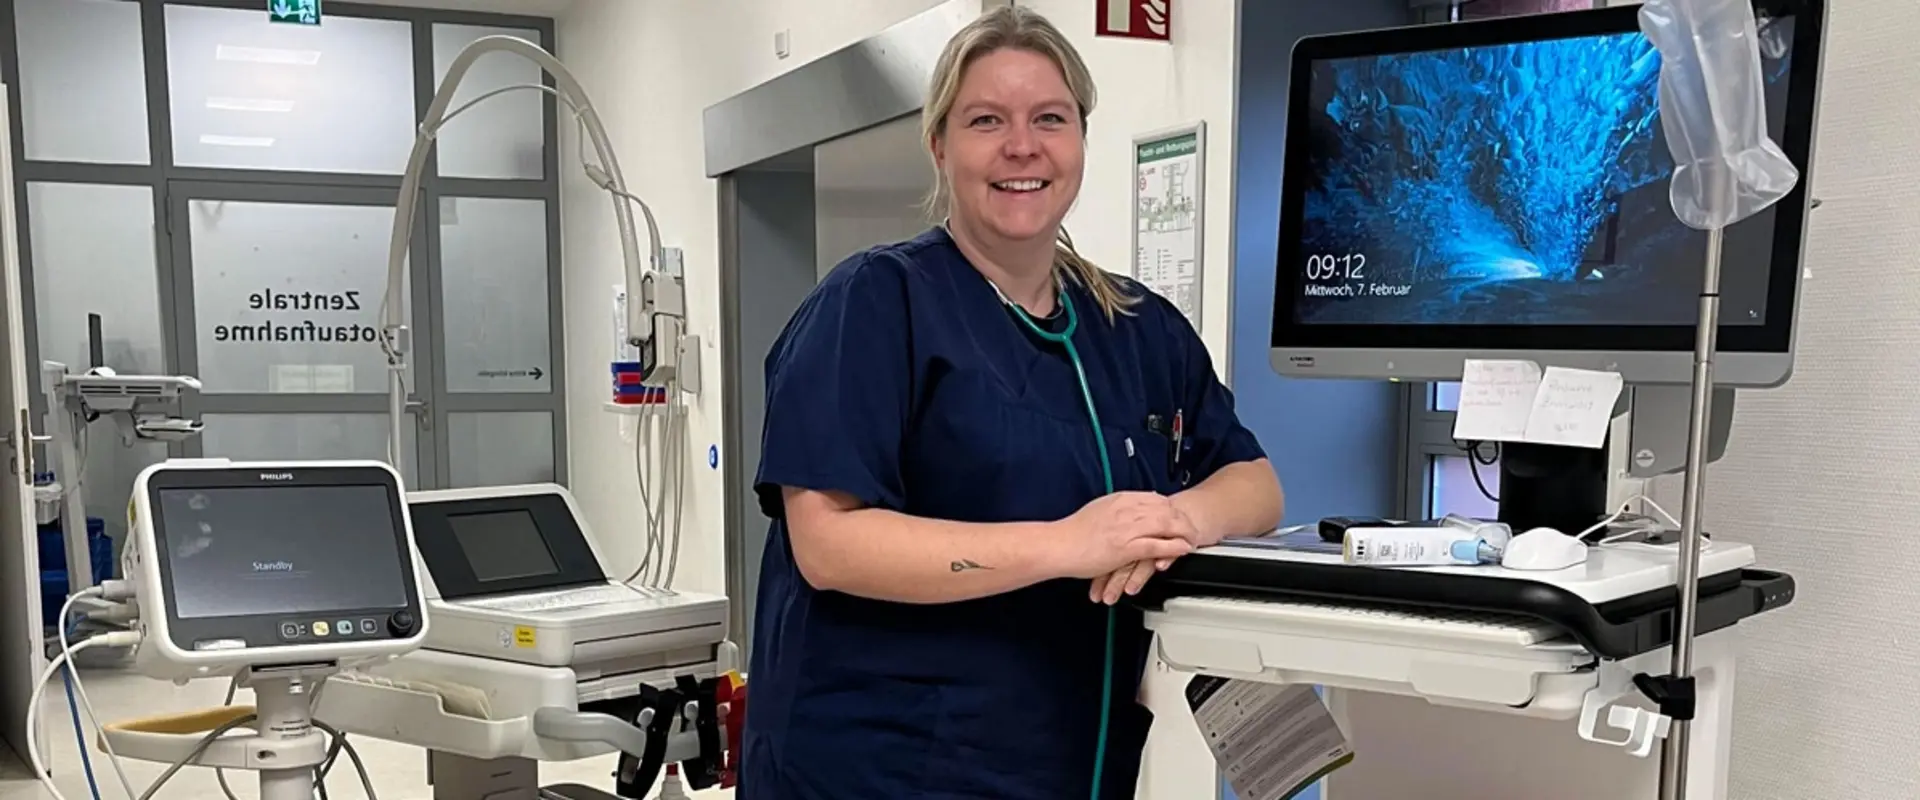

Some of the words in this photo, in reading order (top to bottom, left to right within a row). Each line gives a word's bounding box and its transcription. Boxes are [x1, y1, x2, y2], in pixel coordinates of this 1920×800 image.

[1306, 253, 1366, 280] 09:12
[1304, 283, 1355, 297] Mittwoch,
[1357, 283, 1367, 296] 7.
[1368, 283, 1412, 296] Februar
[252, 561, 294, 572] Standby
